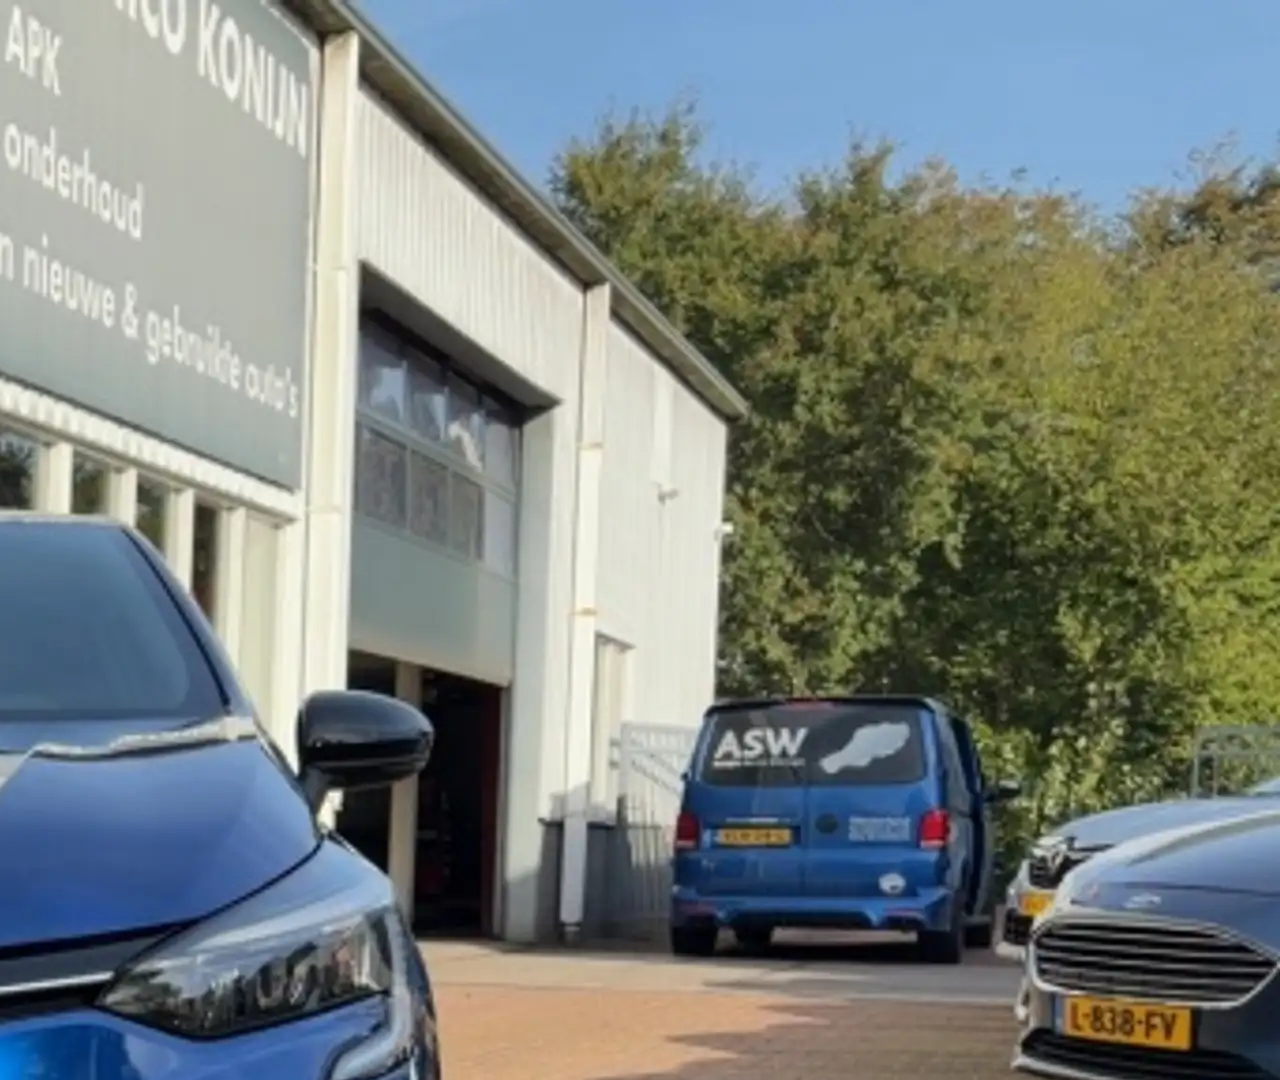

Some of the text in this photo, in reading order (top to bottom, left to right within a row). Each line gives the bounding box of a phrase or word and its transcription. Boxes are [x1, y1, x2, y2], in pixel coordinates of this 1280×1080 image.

[5, 4, 62, 96] APK
[197, 0, 307, 159] KONIJN
[4, 122, 143, 241] onderhoud
[23, 231, 115, 328] nieuwe
[121, 281, 138, 339] &
[145, 304, 240, 390] gebruikte
[245, 363, 298, 418] auto's
[713, 727, 809, 759] ASW
